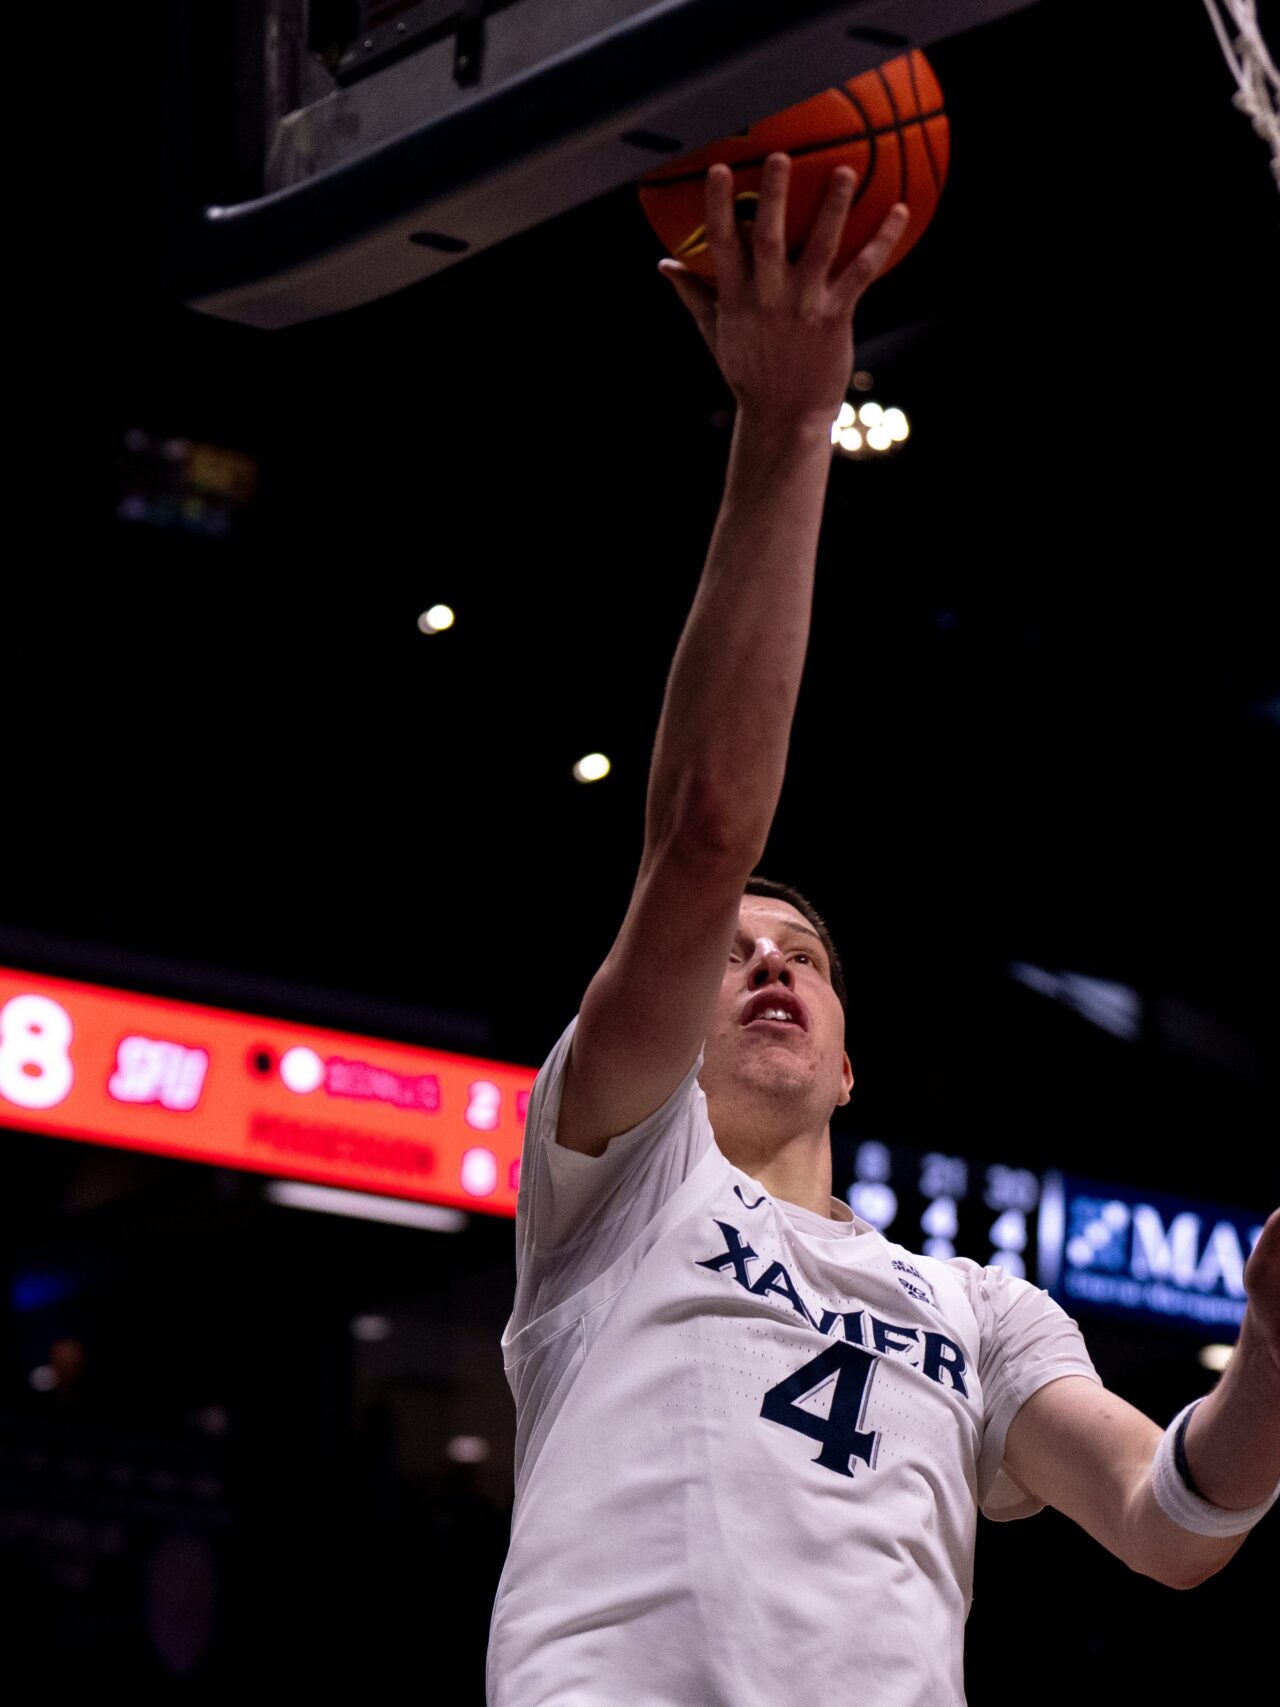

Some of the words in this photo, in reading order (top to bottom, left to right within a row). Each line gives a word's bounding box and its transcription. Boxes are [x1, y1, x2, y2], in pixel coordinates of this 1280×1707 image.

[0, 994, 74, 1110] 8
[695, 1219, 970, 1400] XAVIER
[1131, 1203, 1264, 1301] MA
[759, 1340, 883, 1479] 4
